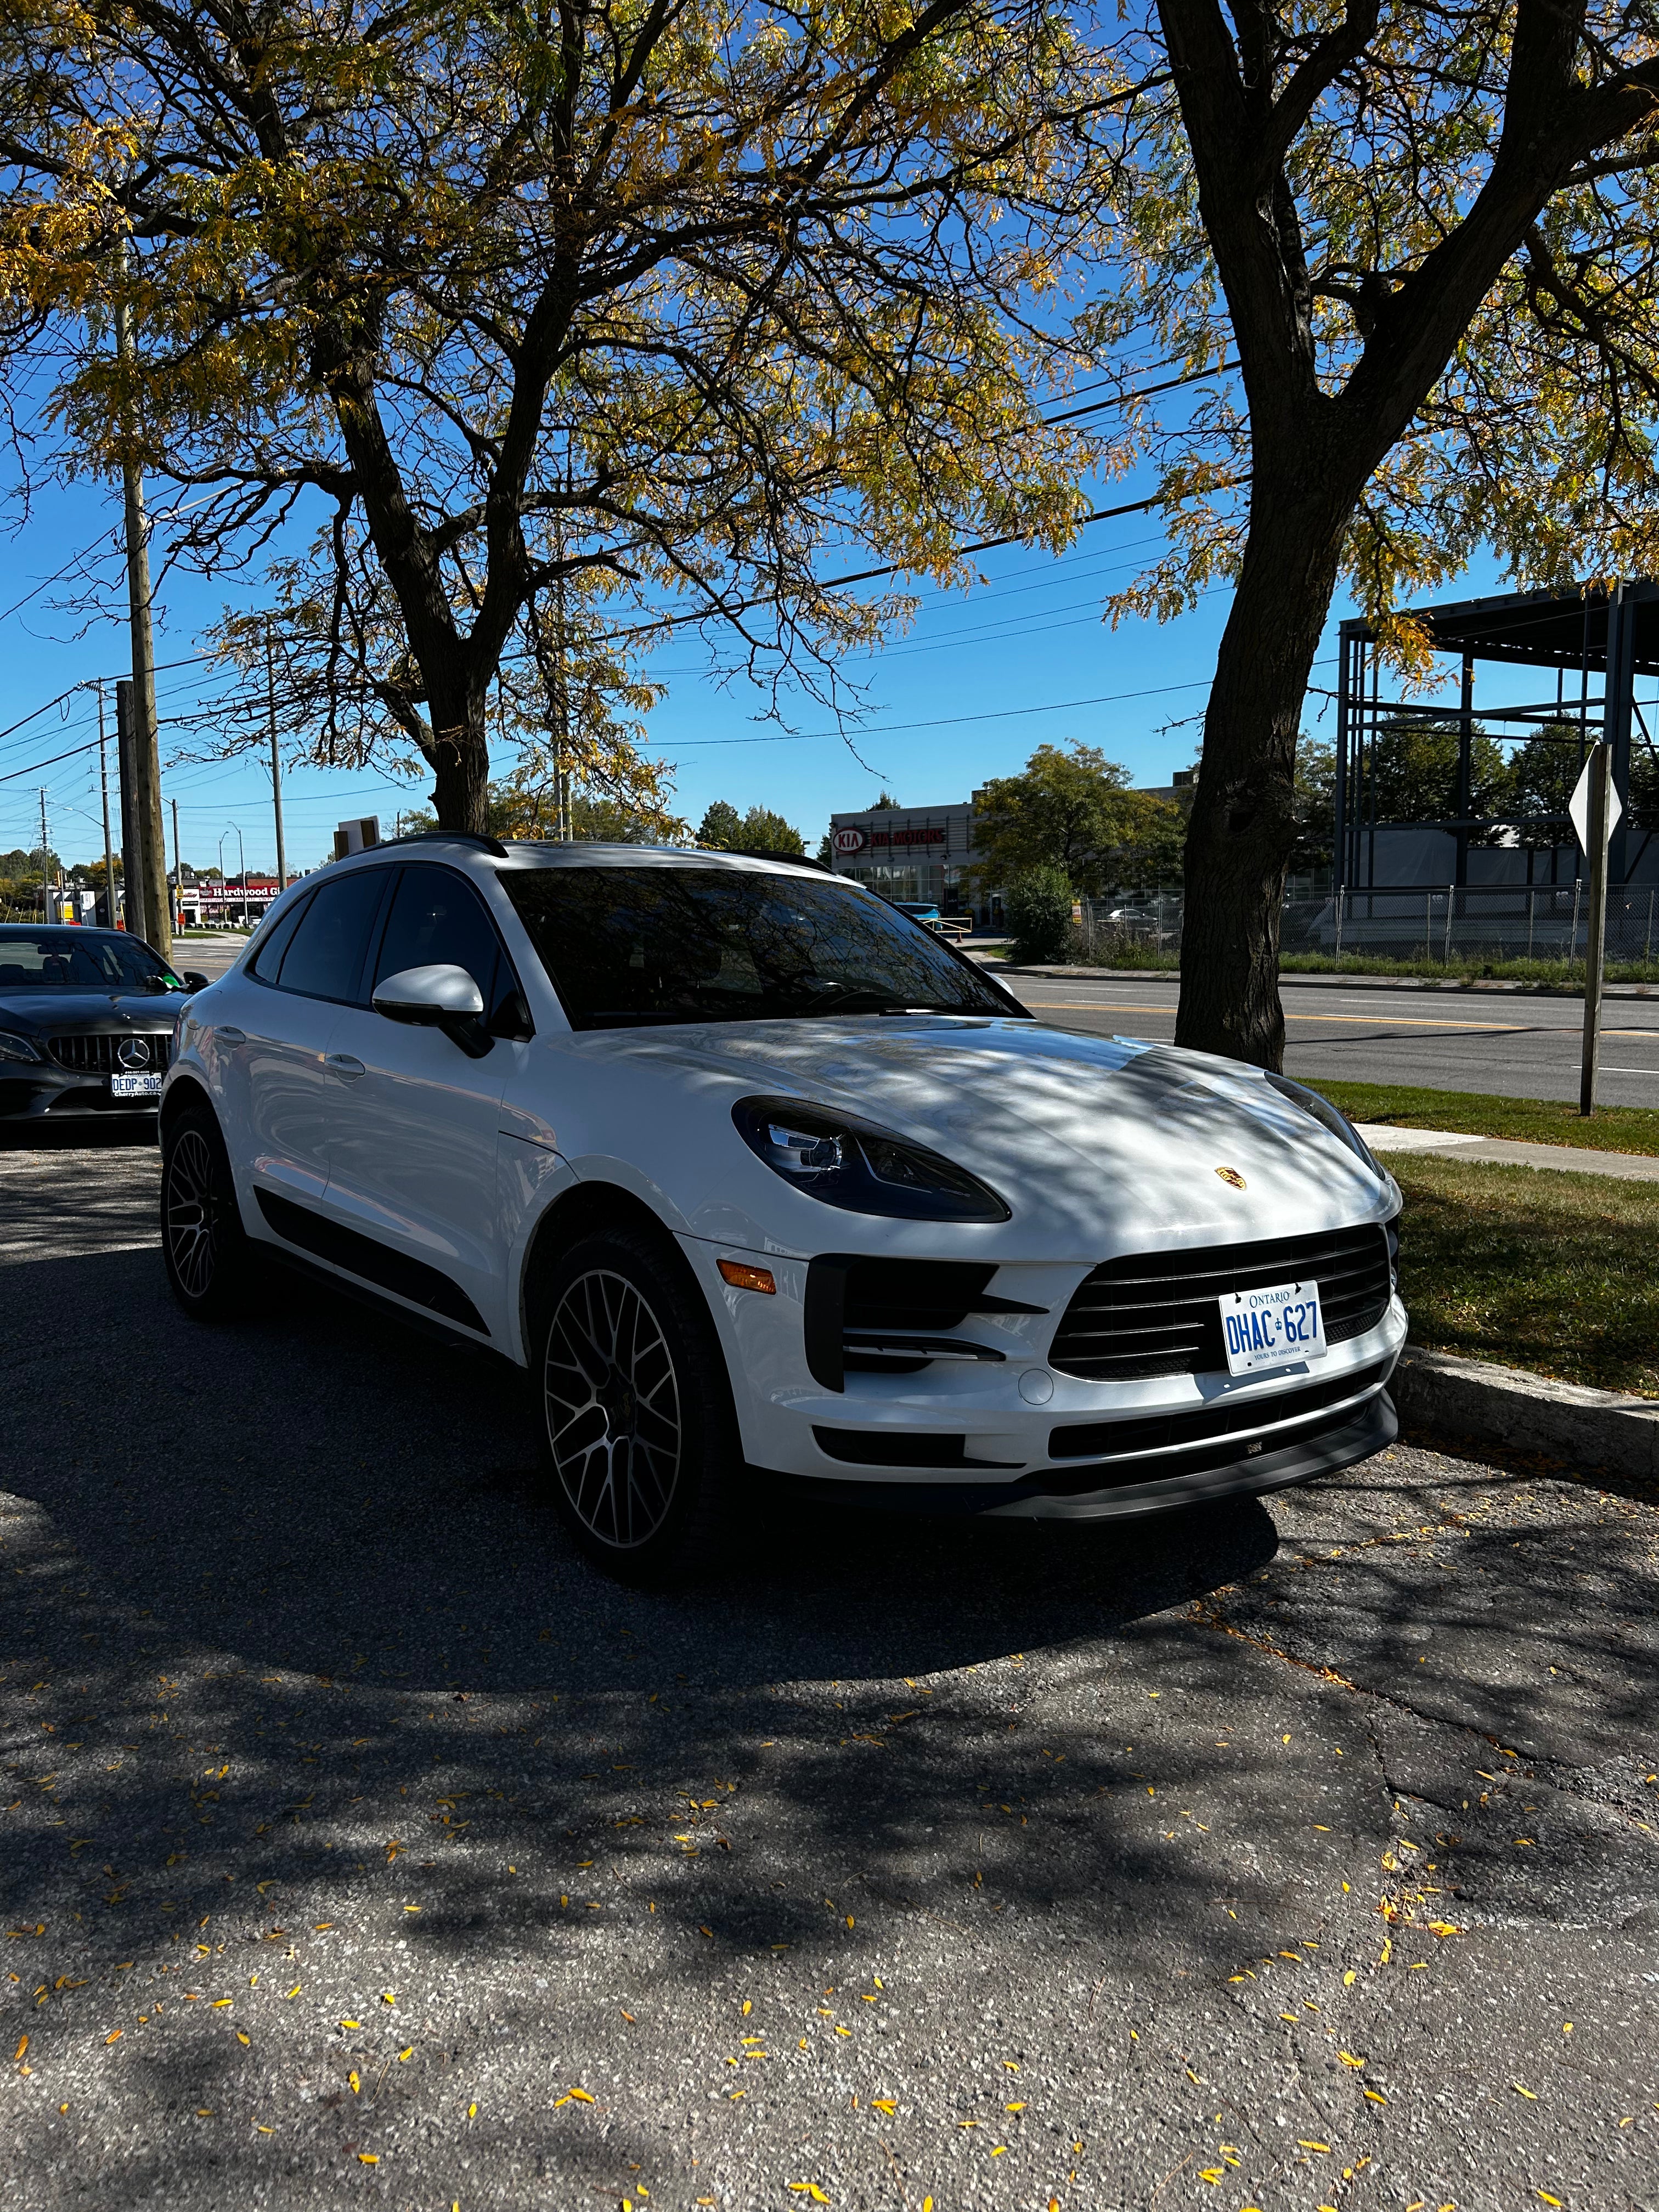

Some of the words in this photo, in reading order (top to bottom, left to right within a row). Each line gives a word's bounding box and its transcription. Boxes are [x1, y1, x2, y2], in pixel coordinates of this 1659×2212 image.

[838, 834, 859, 848] KIA
[871, 832, 889, 847] KIA
[893, 829, 944, 845] MOTORS
[213, 887, 268, 896] Hardwood
[112, 1078, 137, 1091] DEDP
[144, 1077, 162, 1090] 902
[1226, 1310, 1276, 1355] DHAC
[1283, 1301, 1317, 1343] 627
[1278, 1346, 1301, 1355] DISCOVER
